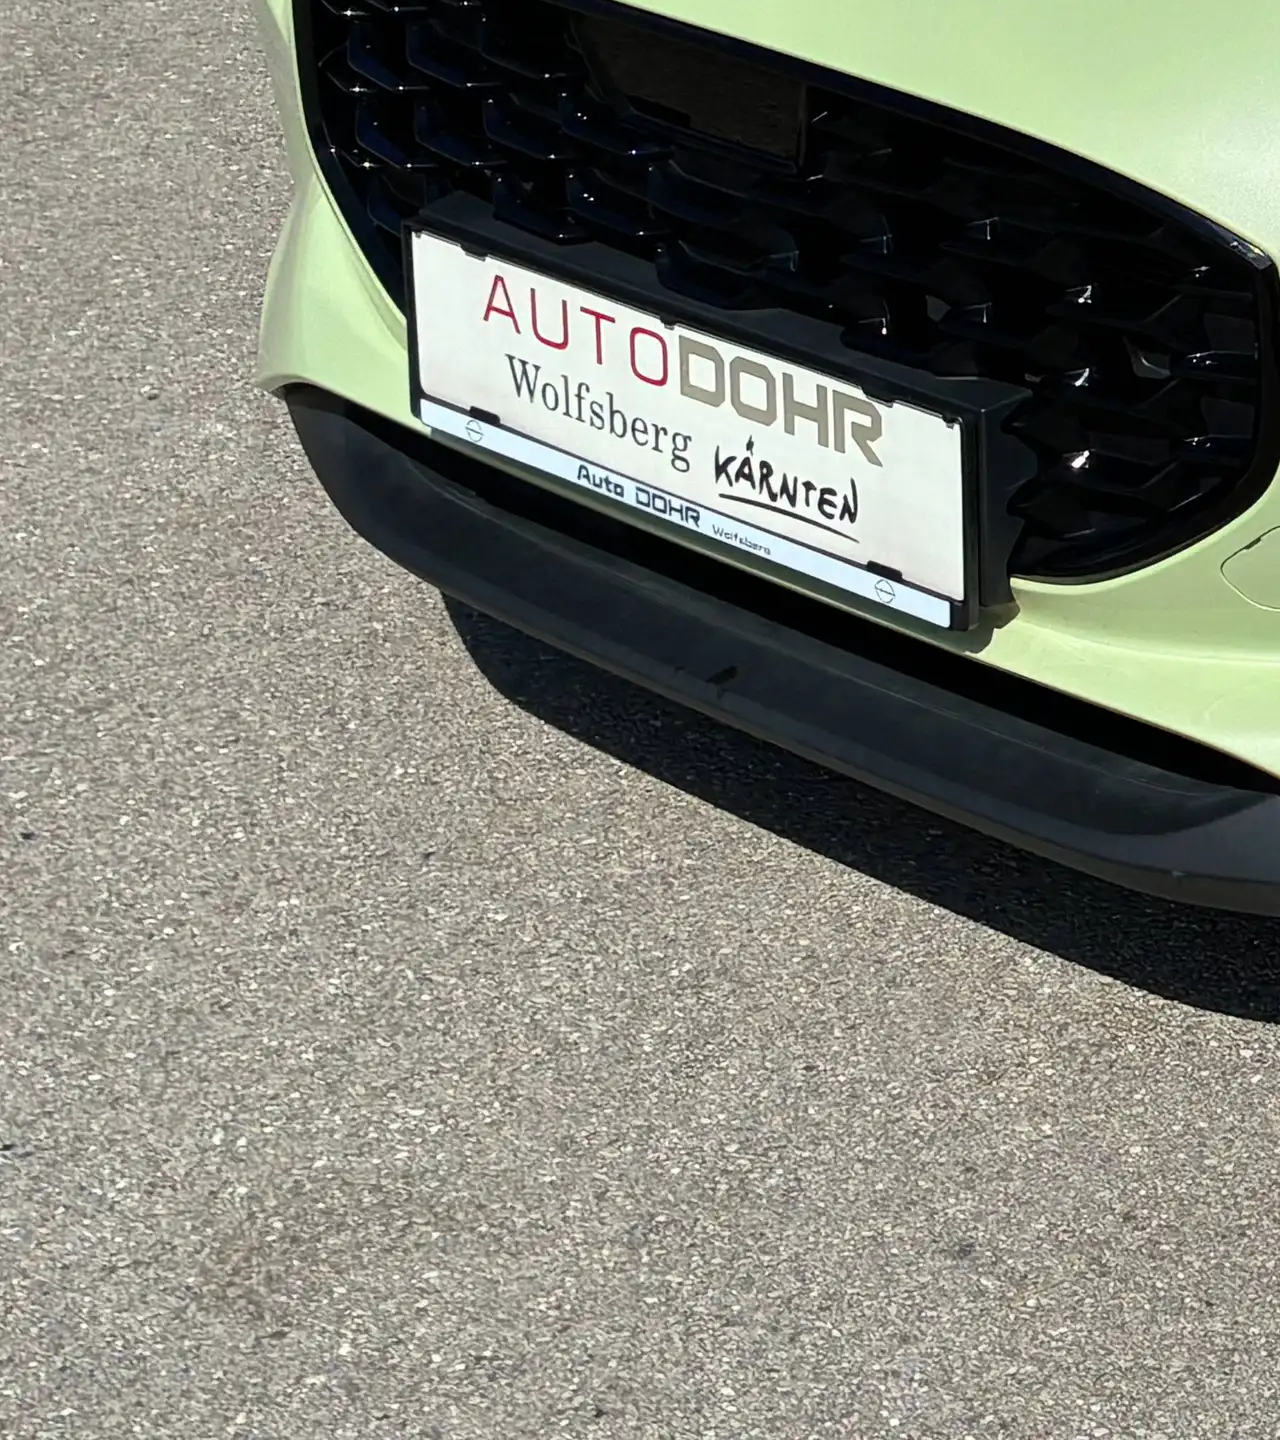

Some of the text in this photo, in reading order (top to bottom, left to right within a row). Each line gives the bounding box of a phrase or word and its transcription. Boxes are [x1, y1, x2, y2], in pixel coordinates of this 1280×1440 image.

[504, 353, 693, 474] Wolfsberg
[577, 464, 625, 499] Auto
[635, 485, 701, 529] DOHR
